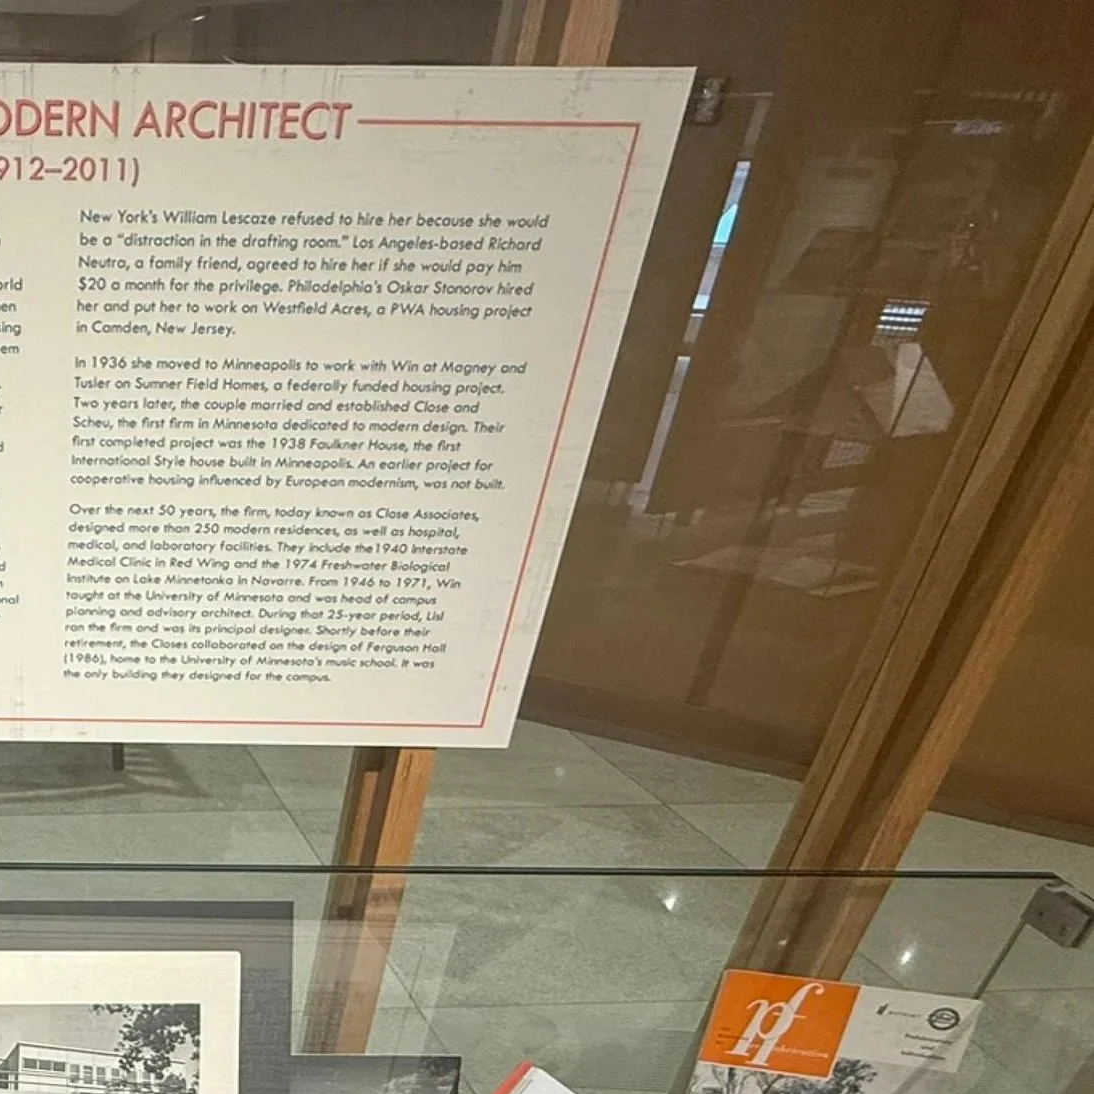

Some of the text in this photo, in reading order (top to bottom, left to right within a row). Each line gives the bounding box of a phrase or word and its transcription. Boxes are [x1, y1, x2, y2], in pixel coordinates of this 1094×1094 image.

[133, 101, 353, 139] ARCHITECT
[80, 209, 112, 223] New
[162, 210, 217, 224] William
[222, 211, 276, 224] Lescaze
[281, 211, 334, 225] refused
[339, 214, 352, 225] to
[357, 212, 384, 226] hire
[388, 212, 412, 226] her
[416, 213, 474, 227] because
[478, 214, 501, 227] she
[507, 215, 550, 228] would
[78, 255, 521, 276] Neutra, a family friend, agreed to hire her if she would pay him
[75, 356, 527, 376] In 1936 she moved to Minneapolis to work with Win at Magney and
[67, 556, 450, 574] Medical Clinic in Red Wing and the 1974 Freshwater Biological
[63, 669, 330, 683] the only building they designed for the campus.
